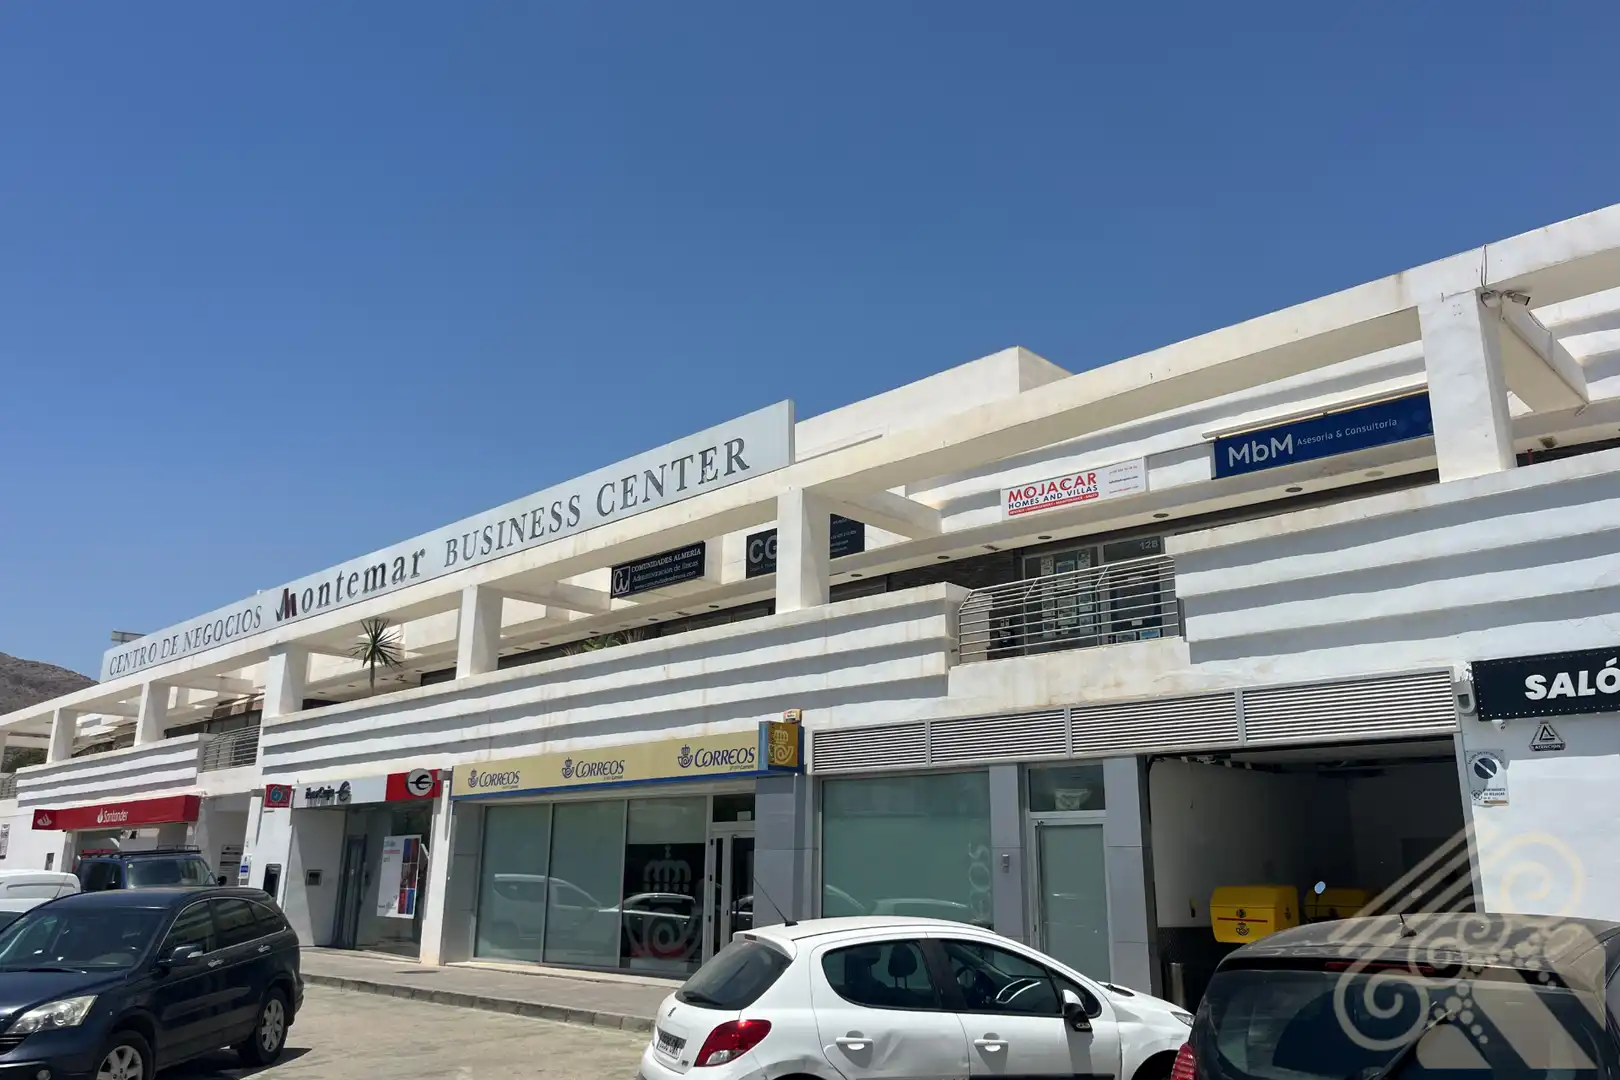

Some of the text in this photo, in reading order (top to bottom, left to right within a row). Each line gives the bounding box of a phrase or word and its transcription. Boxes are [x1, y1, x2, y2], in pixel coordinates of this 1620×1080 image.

[1335, 427, 1343, 438] &
[1227, 433, 1293, 468] MbM
[1008, 472, 1097, 503] MOJACAR
[1008, 497, 1040, 510] HOMES
[1043, 492, 1063, 502] AND
[1067, 484, 1098, 497] VILLAS
[109, 437, 750, 676] CENTRO DE NEGOCIOS Montemar BUSINESS CENTER
[1524, 657, 1620, 701] SALÓ
[575, 760, 625, 778] CORREOS
[694, 746, 755, 768] CORREOS
[479, 770, 520, 787] CORREOS
[103, 810, 128, 823] Santander
